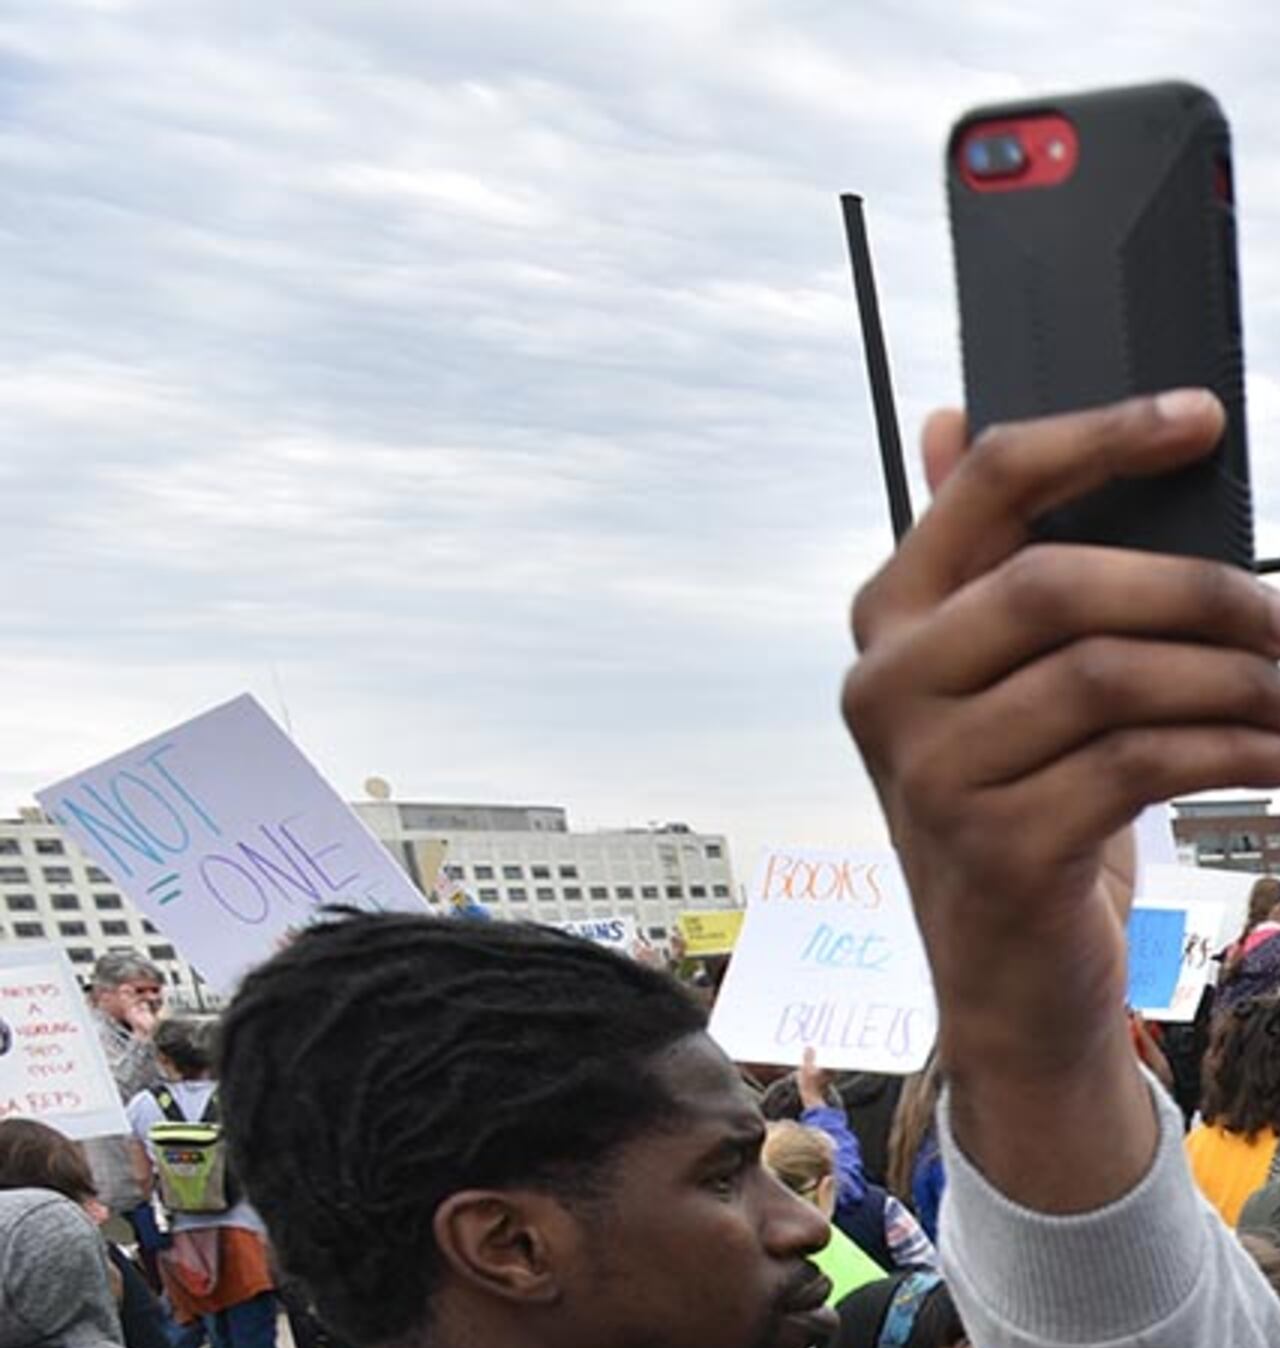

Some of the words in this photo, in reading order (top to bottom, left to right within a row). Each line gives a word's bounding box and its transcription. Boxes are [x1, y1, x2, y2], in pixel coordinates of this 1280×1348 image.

[62, 744, 221, 878] NOT
[200, 816, 360, 925] ONE
[763, 854, 883, 909] BOOKS
[801, 921, 891, 972] not
[774, 1000, 921, 1057] BULLETS
